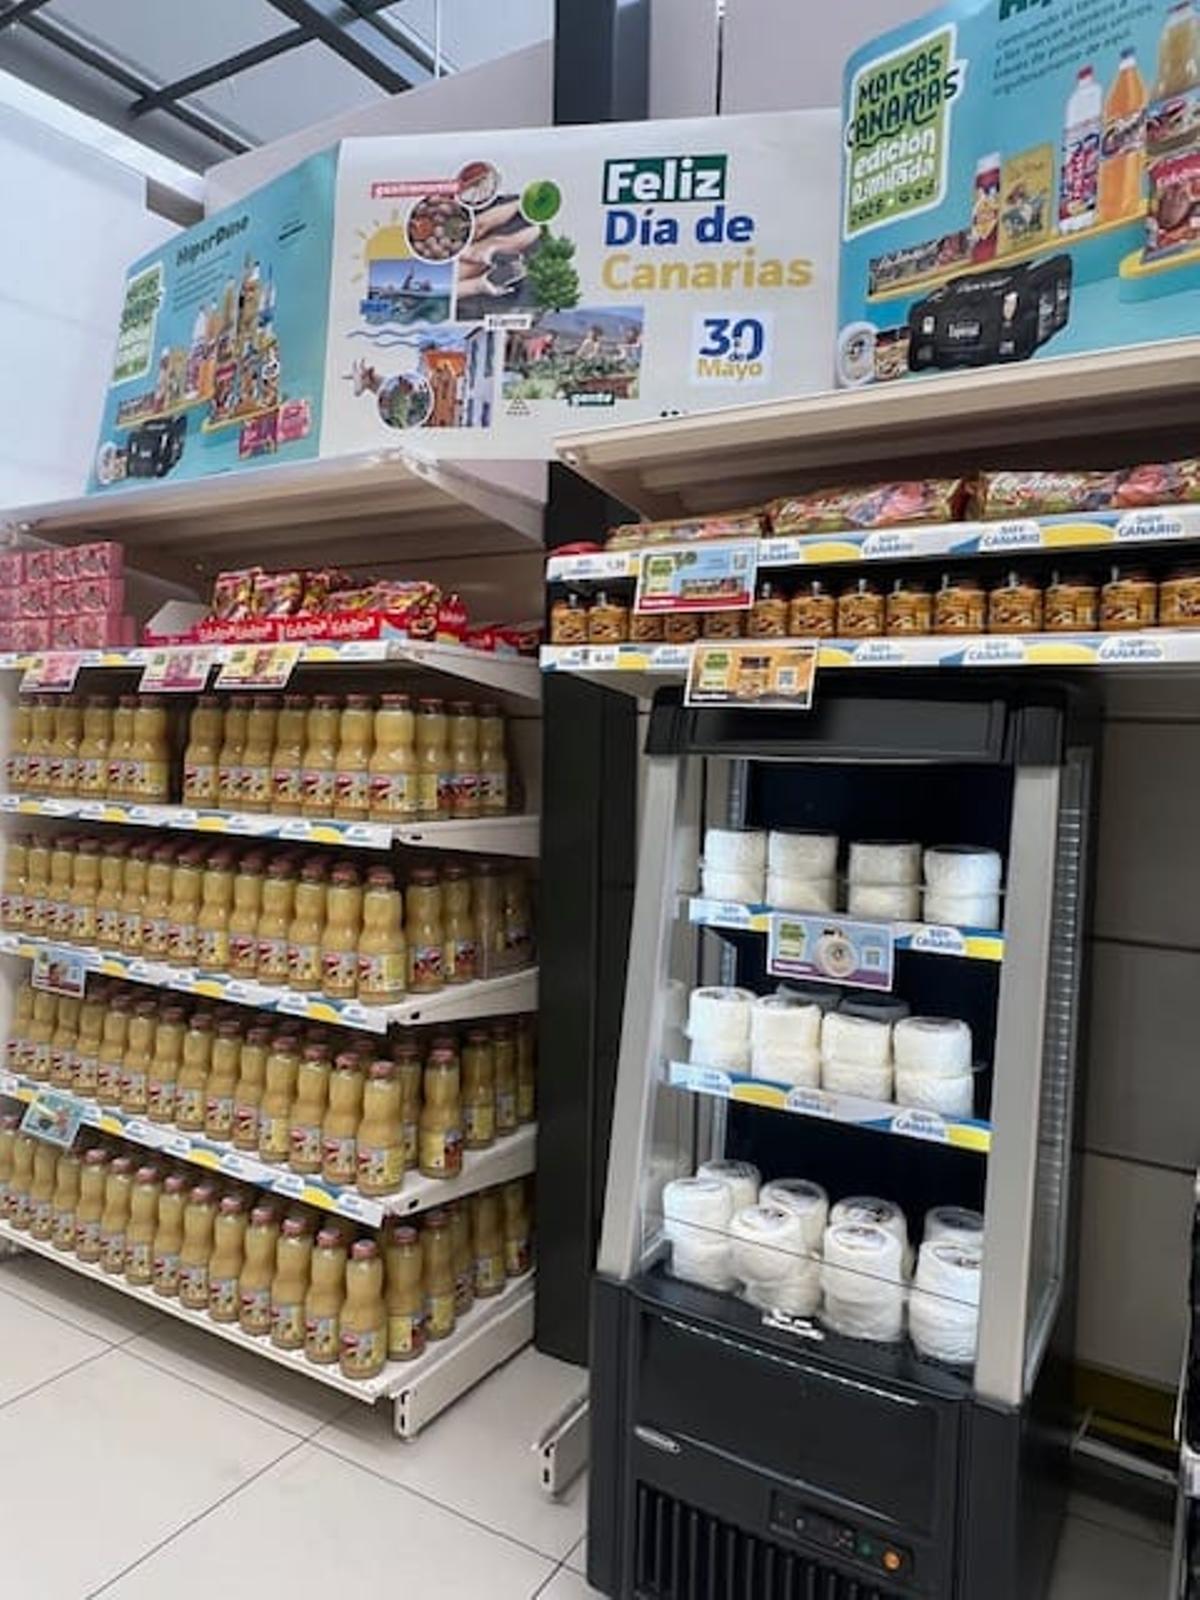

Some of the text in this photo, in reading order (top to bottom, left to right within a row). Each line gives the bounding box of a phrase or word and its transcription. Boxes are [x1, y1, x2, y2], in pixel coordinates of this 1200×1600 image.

[606, 158, 722, 203] Feliz
[605, 204, 755, 246] Día de
[601, 248, 814, 291] Canarias
[699, 318, 764, 361] 30
[697, 358, 763, 381] Mayo
